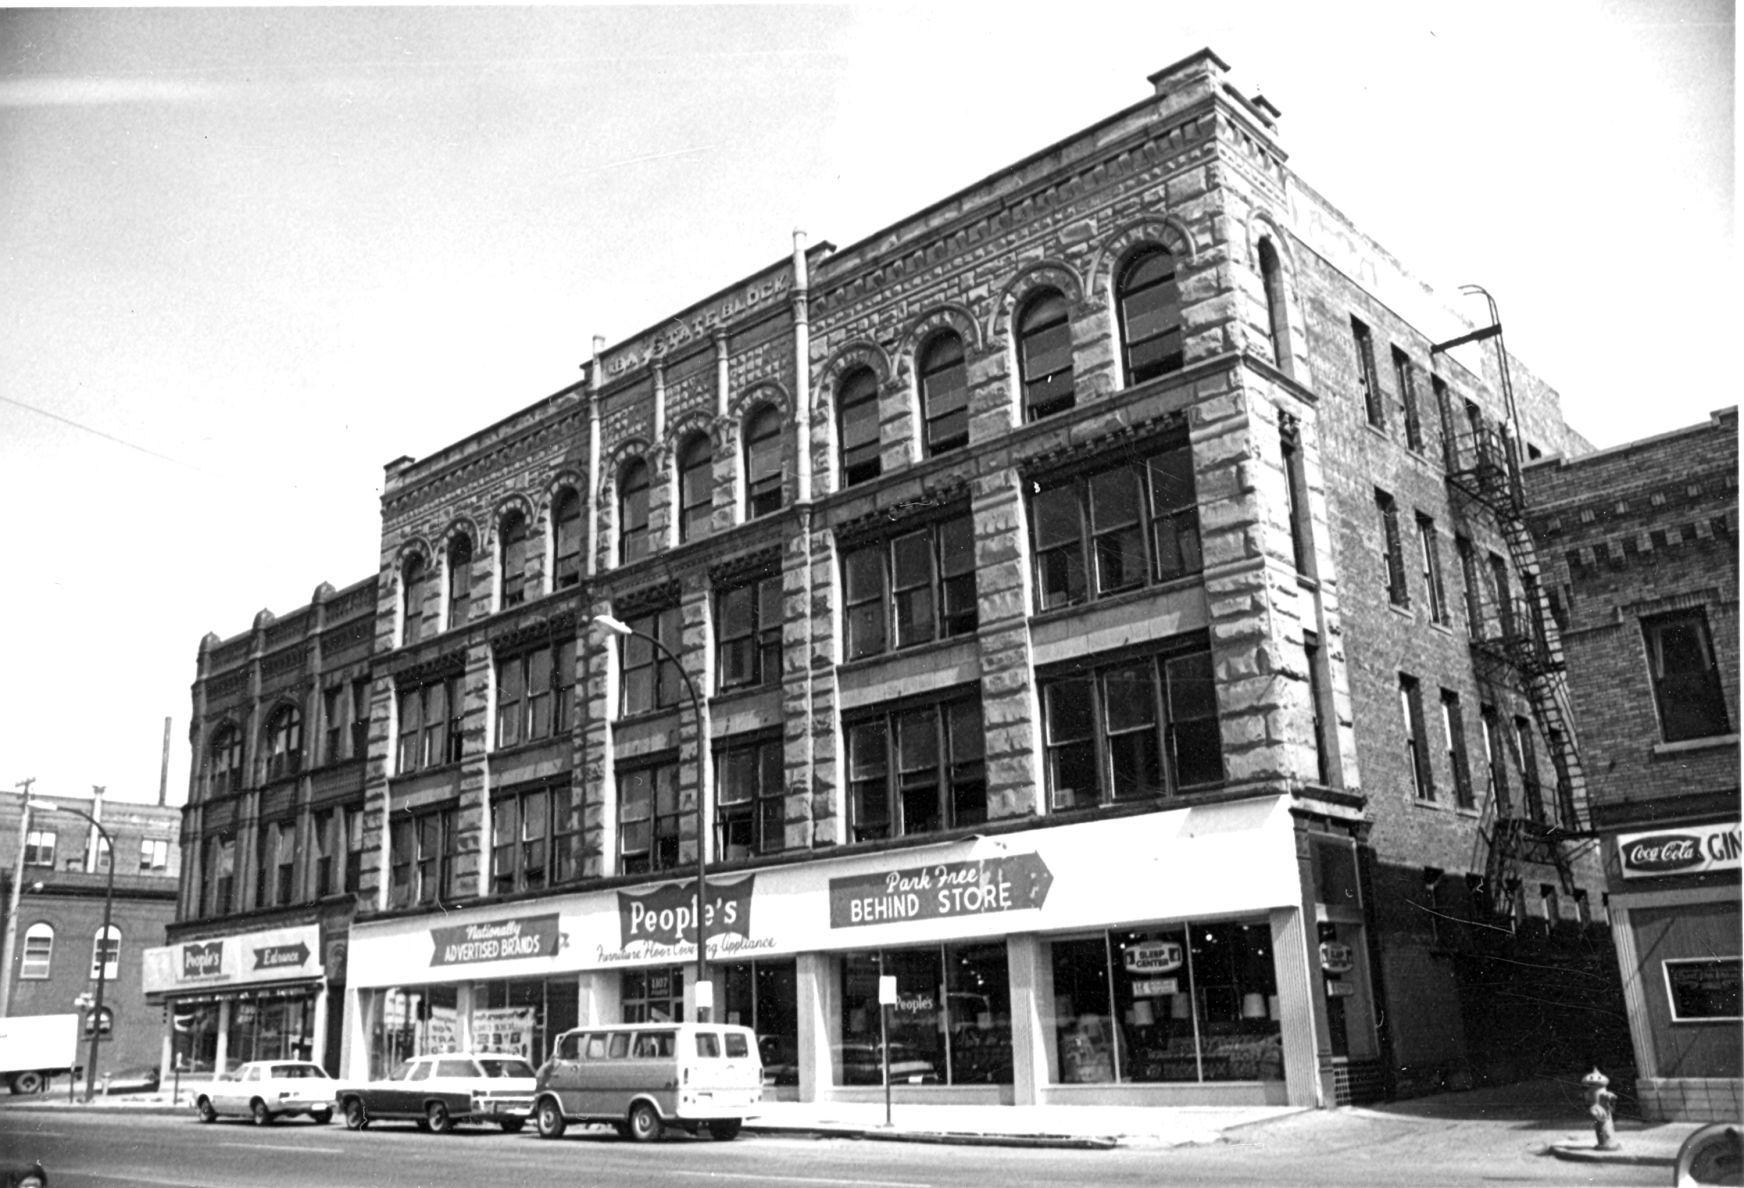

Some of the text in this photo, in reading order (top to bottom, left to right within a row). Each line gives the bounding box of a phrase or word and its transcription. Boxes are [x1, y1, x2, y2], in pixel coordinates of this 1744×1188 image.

[722, 272, 787, 320] BLOCK
[886, 865, 978, 893] Park Free
[630, 894, 738, 939] People's
[850, 882, 1013, 923] BEHIND STORE
[466, 920, 522, 940] Nationally
[444, 934, 540, 962] ADVERTISED BRANDS
[597, 932, 776, 963] Furniture Floor Coveng Appliance
[1139, 949, 1165, 960] SLEEP
[184, 948, 220, 977] People's
[1136, 958, 1169, 968] CENTER
[894, 993, 933, 1015] People's
